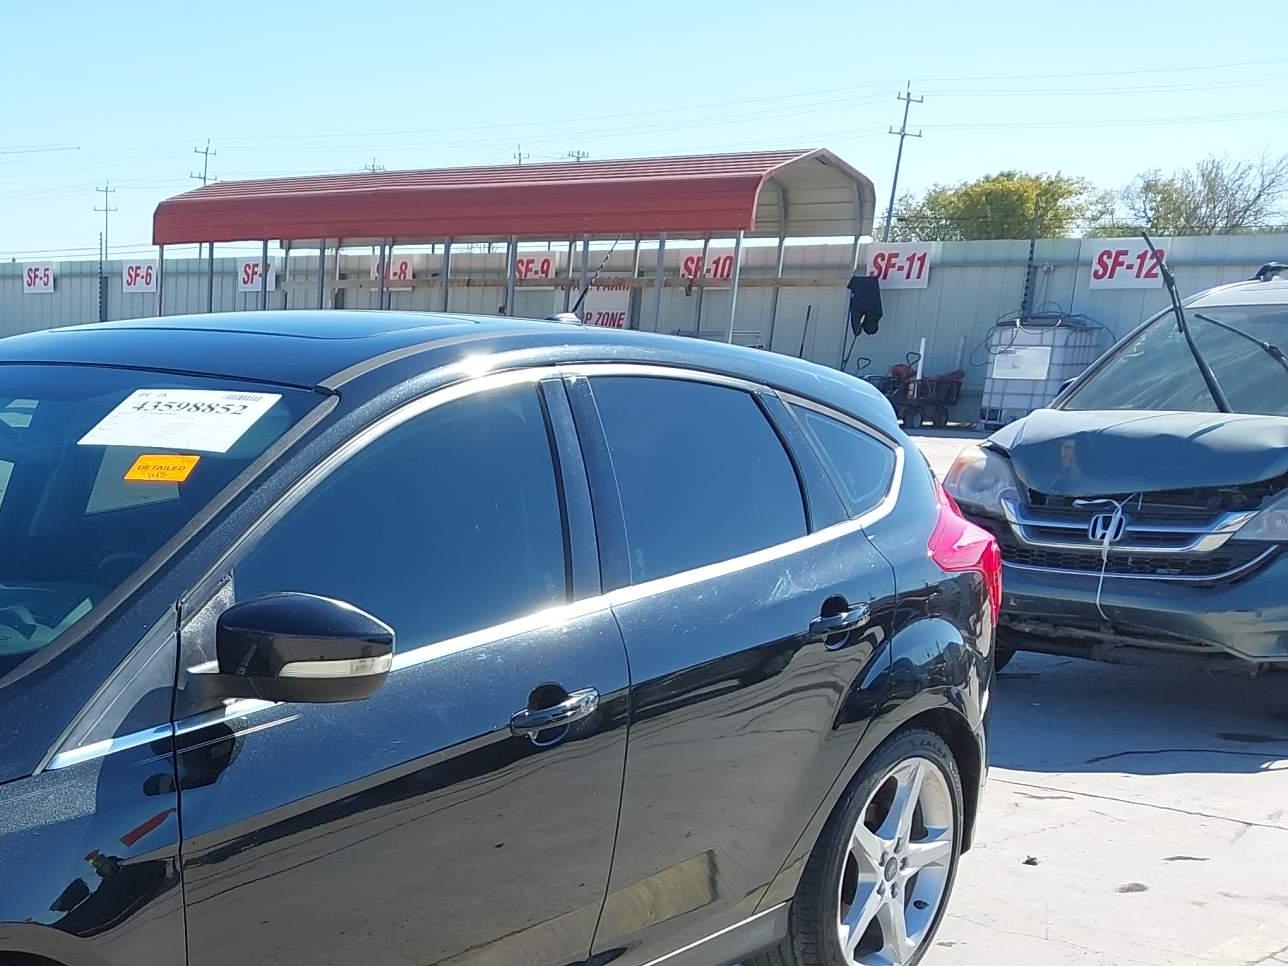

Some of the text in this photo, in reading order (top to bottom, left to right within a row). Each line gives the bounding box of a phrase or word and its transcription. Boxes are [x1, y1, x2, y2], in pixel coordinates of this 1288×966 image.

[870, 252, 928, 280] SF-11
[1093, 249, 1165, 279] SF-12
[27, 267, 50, 287] SF-5
[126, 265, 153, 286] SF-6
[132, 400, 249, 415] 43598852
